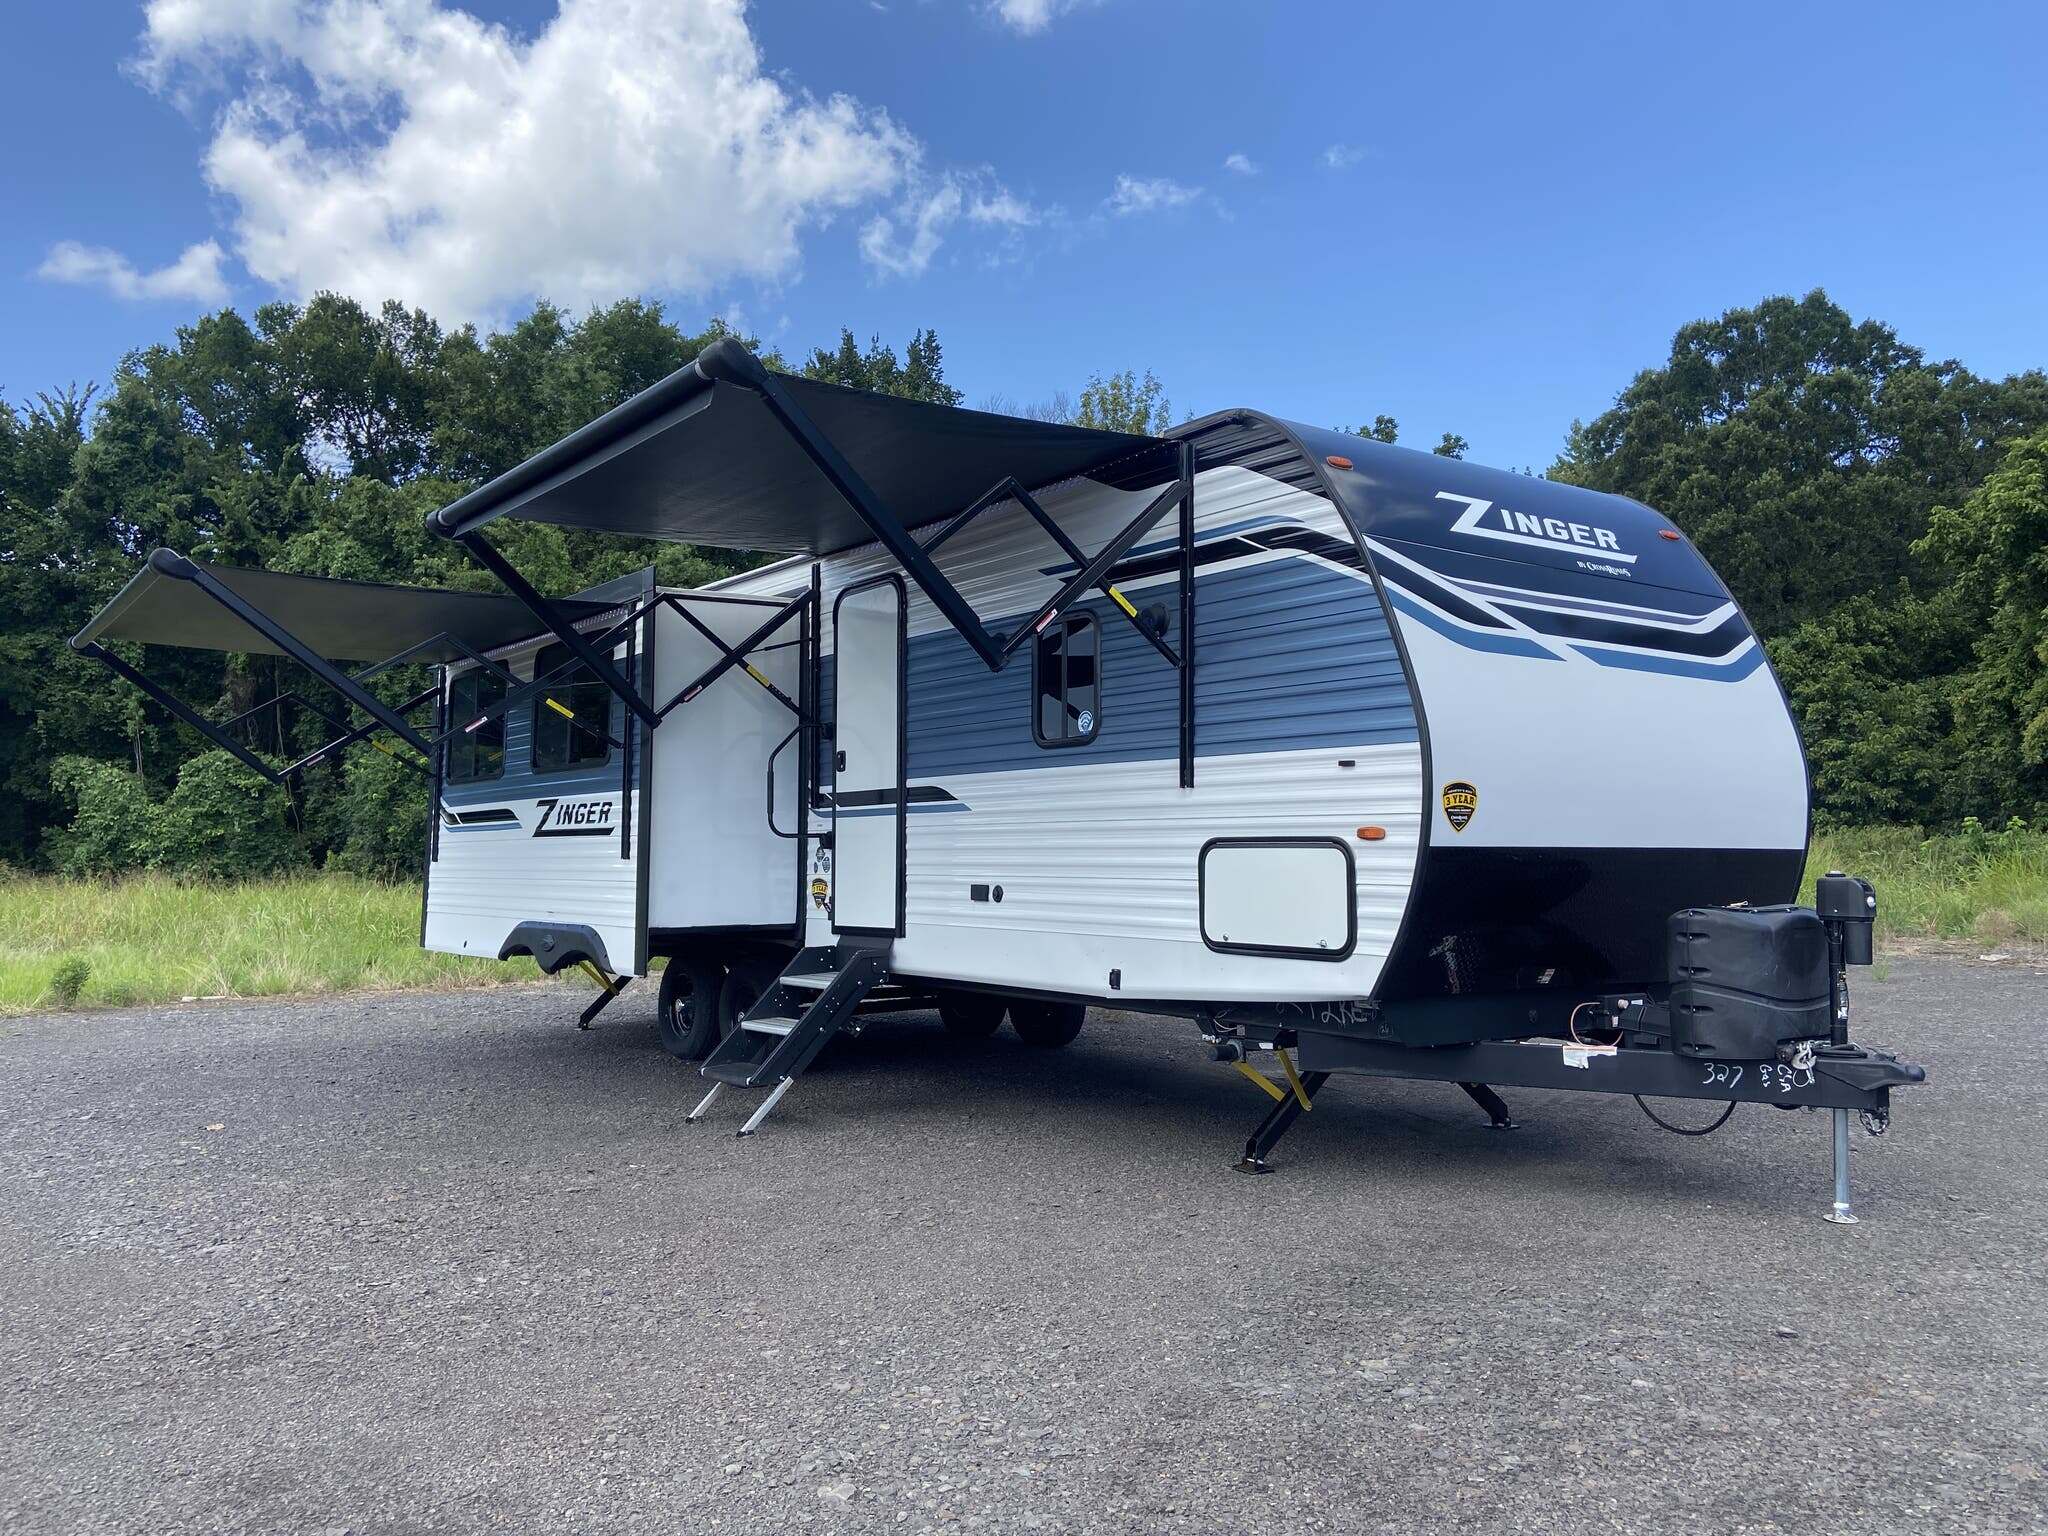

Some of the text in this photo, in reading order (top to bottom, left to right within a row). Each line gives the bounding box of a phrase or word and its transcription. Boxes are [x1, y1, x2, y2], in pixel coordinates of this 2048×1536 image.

[1434, 491, 1638, 563] ZINGER
[1445, 794, 1475, 806] 3 YEAR
[532, 798, 616, 837] ZINGER
[1702, 1062, 1744, 1089] 327
